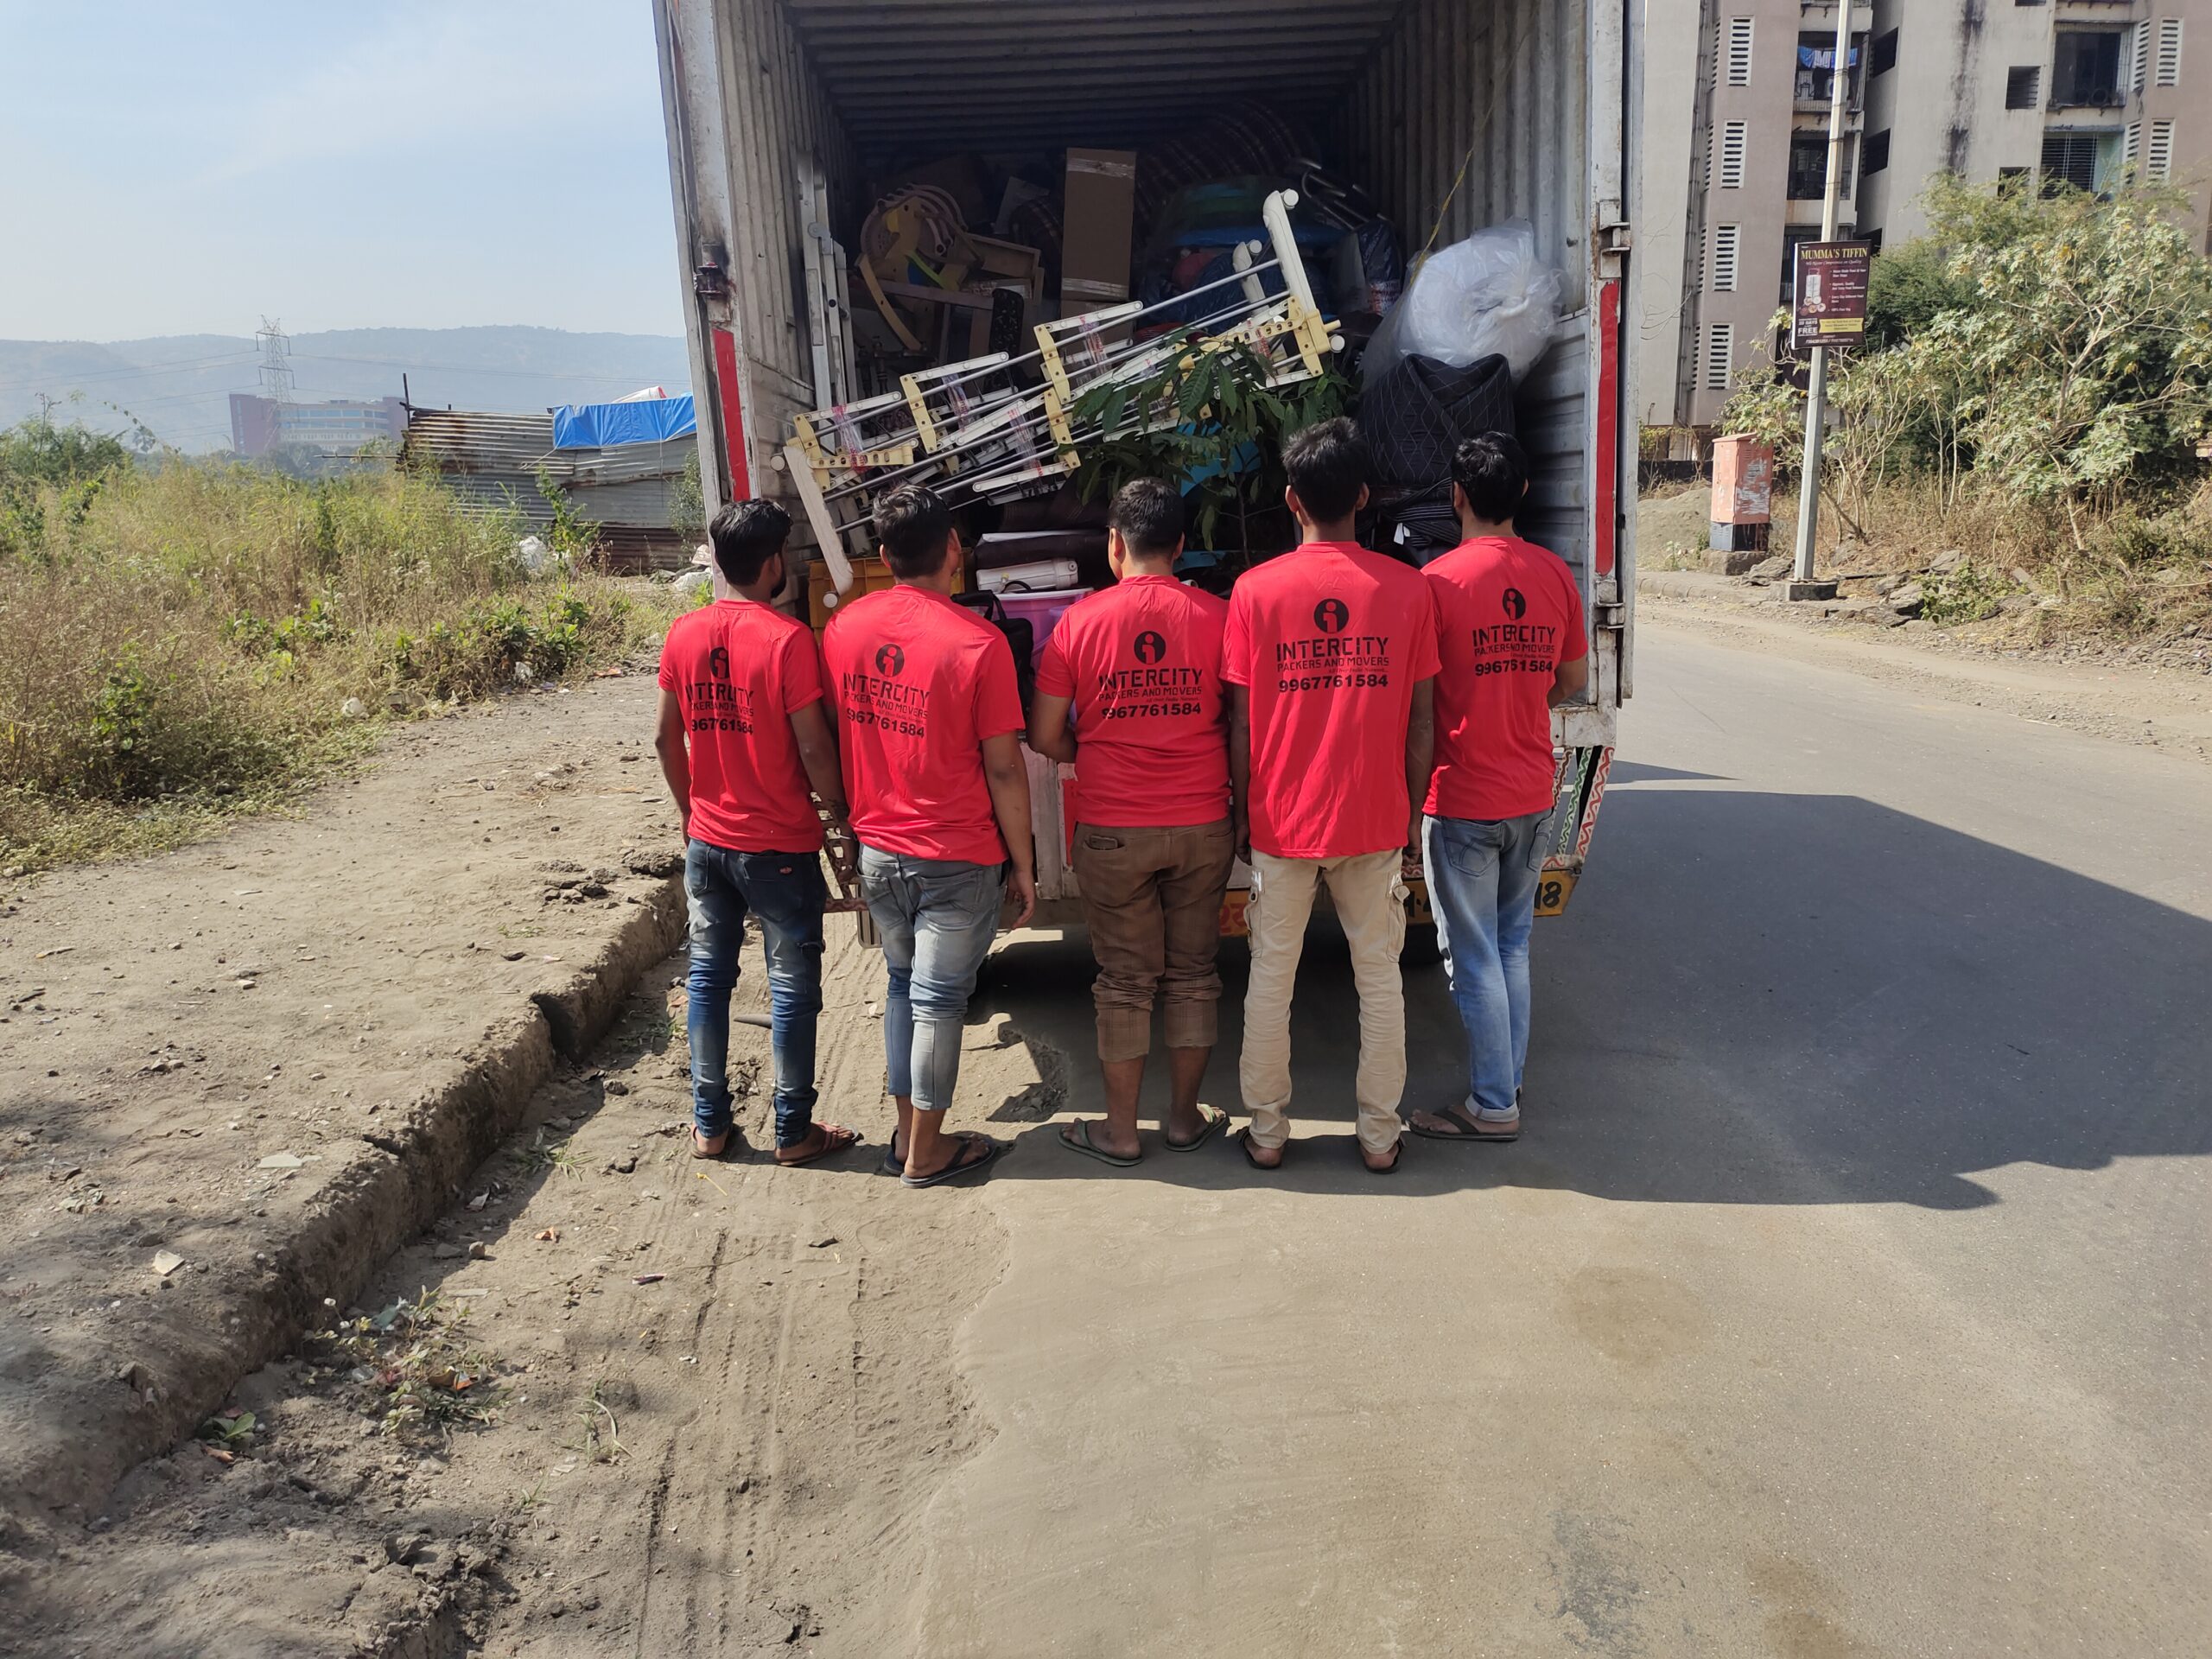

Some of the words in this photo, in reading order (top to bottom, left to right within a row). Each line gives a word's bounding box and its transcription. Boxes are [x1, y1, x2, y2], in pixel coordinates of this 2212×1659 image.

[1801, 249, 1840, 259] MUMMA'S
[1842, 248, 1868, 258] TIFFIN
[1276, 637, 1389, 662] INTERCITY
[1522, 644, 1554, 653] MOVERS
[1278, 659, 1321, 672] PACKERS
[1325, 658, 1344, 667] AND
[1348, 657, 1389, 667] MOVERS
[1098, 668, 1203, 690] INTERCITY
[1279, 674, 1389, 692] 9967761584
[843, 672, 930, 708] INTERCITY
[1141, 688, 1160, 697] AND
[1163, 686, 1201, 696] MOVERS
[875, 699, 893, 710] AND
[895, 703, 928, 719] MOVERS
